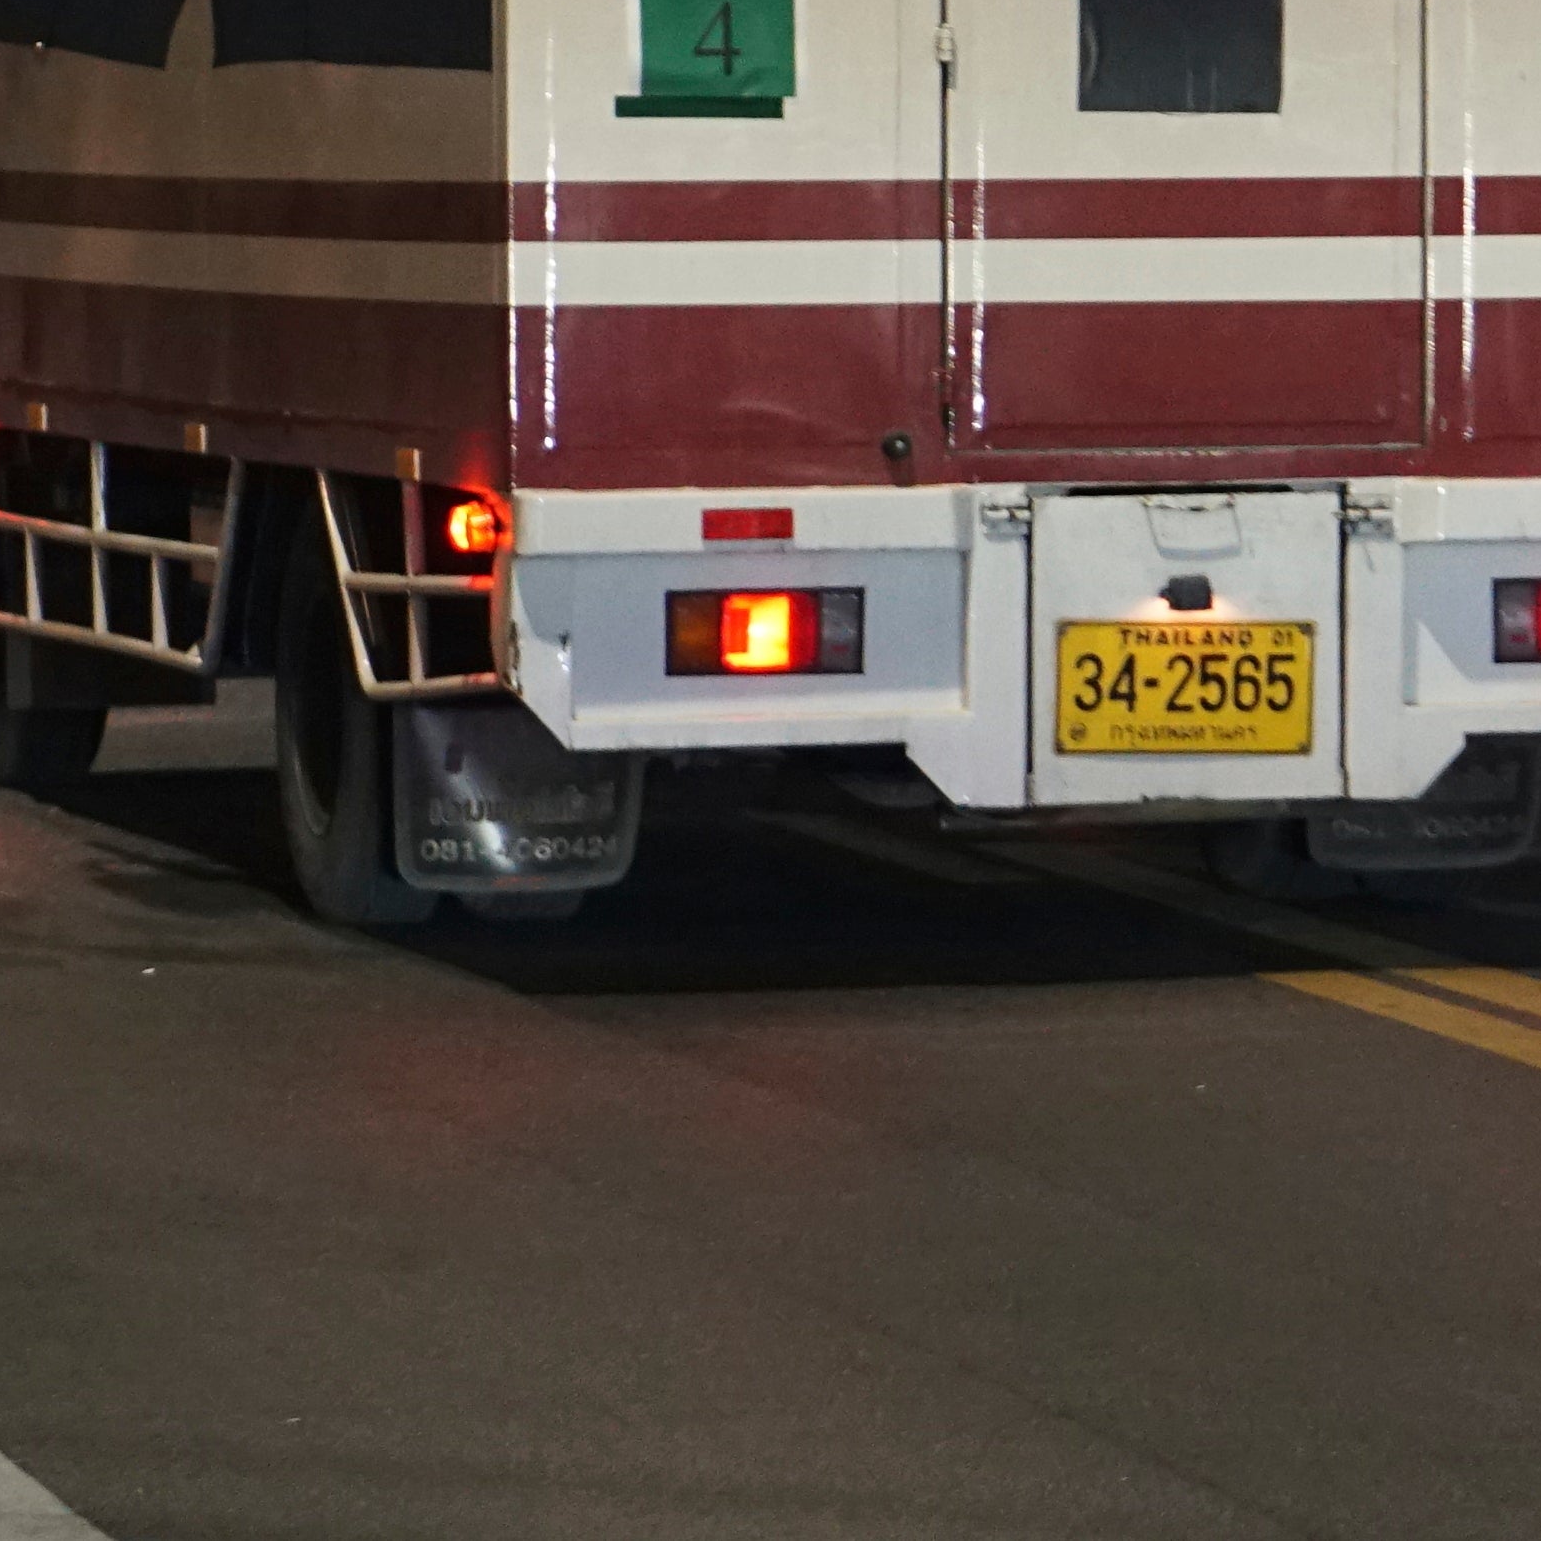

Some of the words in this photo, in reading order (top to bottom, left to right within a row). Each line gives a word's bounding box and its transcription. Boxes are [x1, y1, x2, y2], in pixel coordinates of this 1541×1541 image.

[694, 1, 742, 76] 4
[1120, 629, 1253, 648] THAILAND
[1074, 653, 1295, 712] 34-2565
